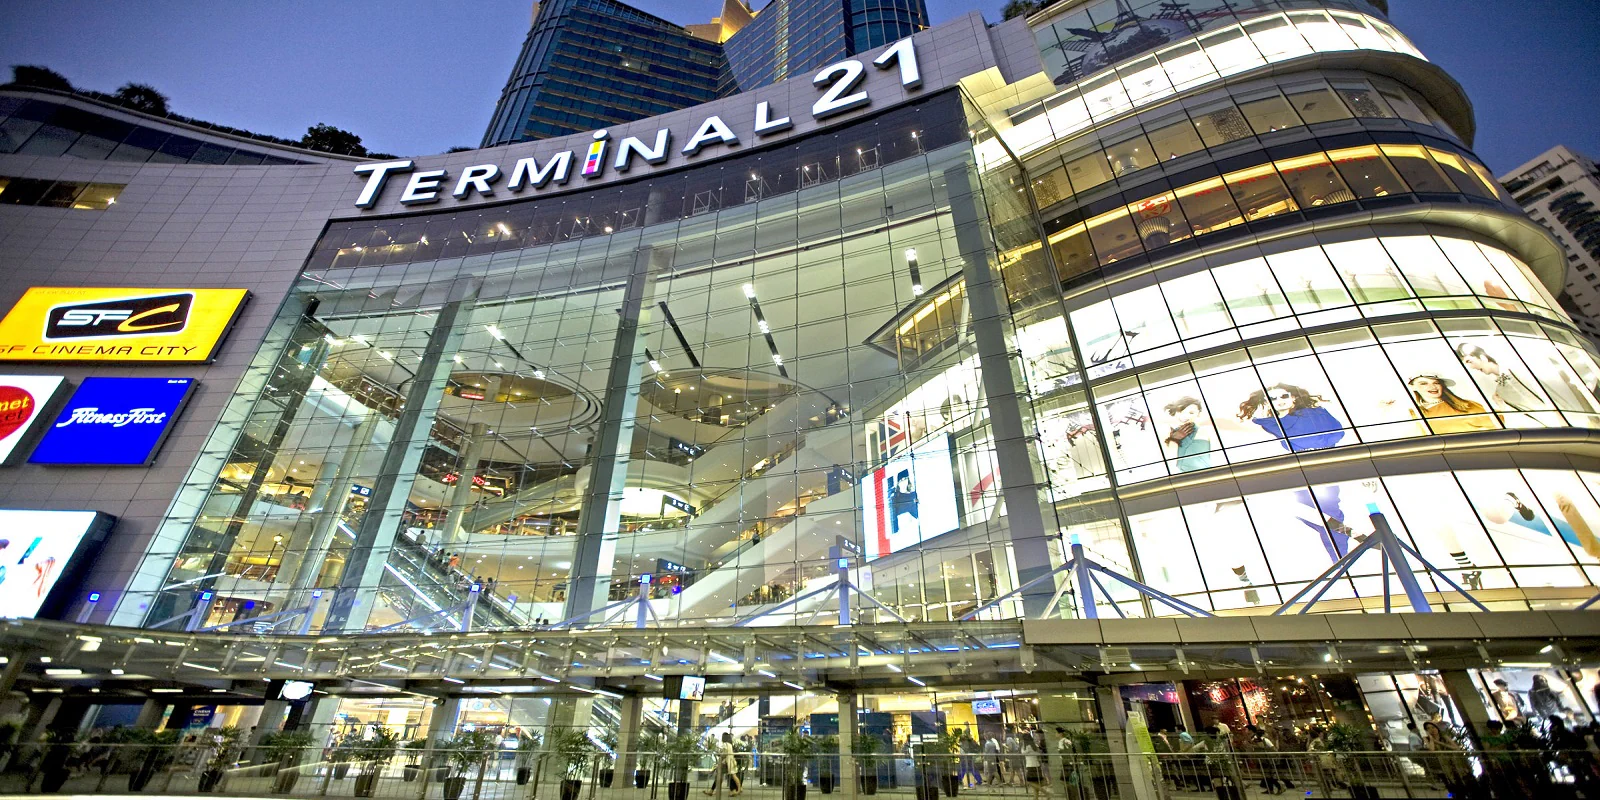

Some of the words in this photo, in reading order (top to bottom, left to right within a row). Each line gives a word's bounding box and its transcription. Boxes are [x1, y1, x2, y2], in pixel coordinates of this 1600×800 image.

[812, 36, 923, 121] 21
[57, 303, 183, 332] SFC
[33, 345, 130, 355] CINEMA
[140, 345, 198, 356] CITY
